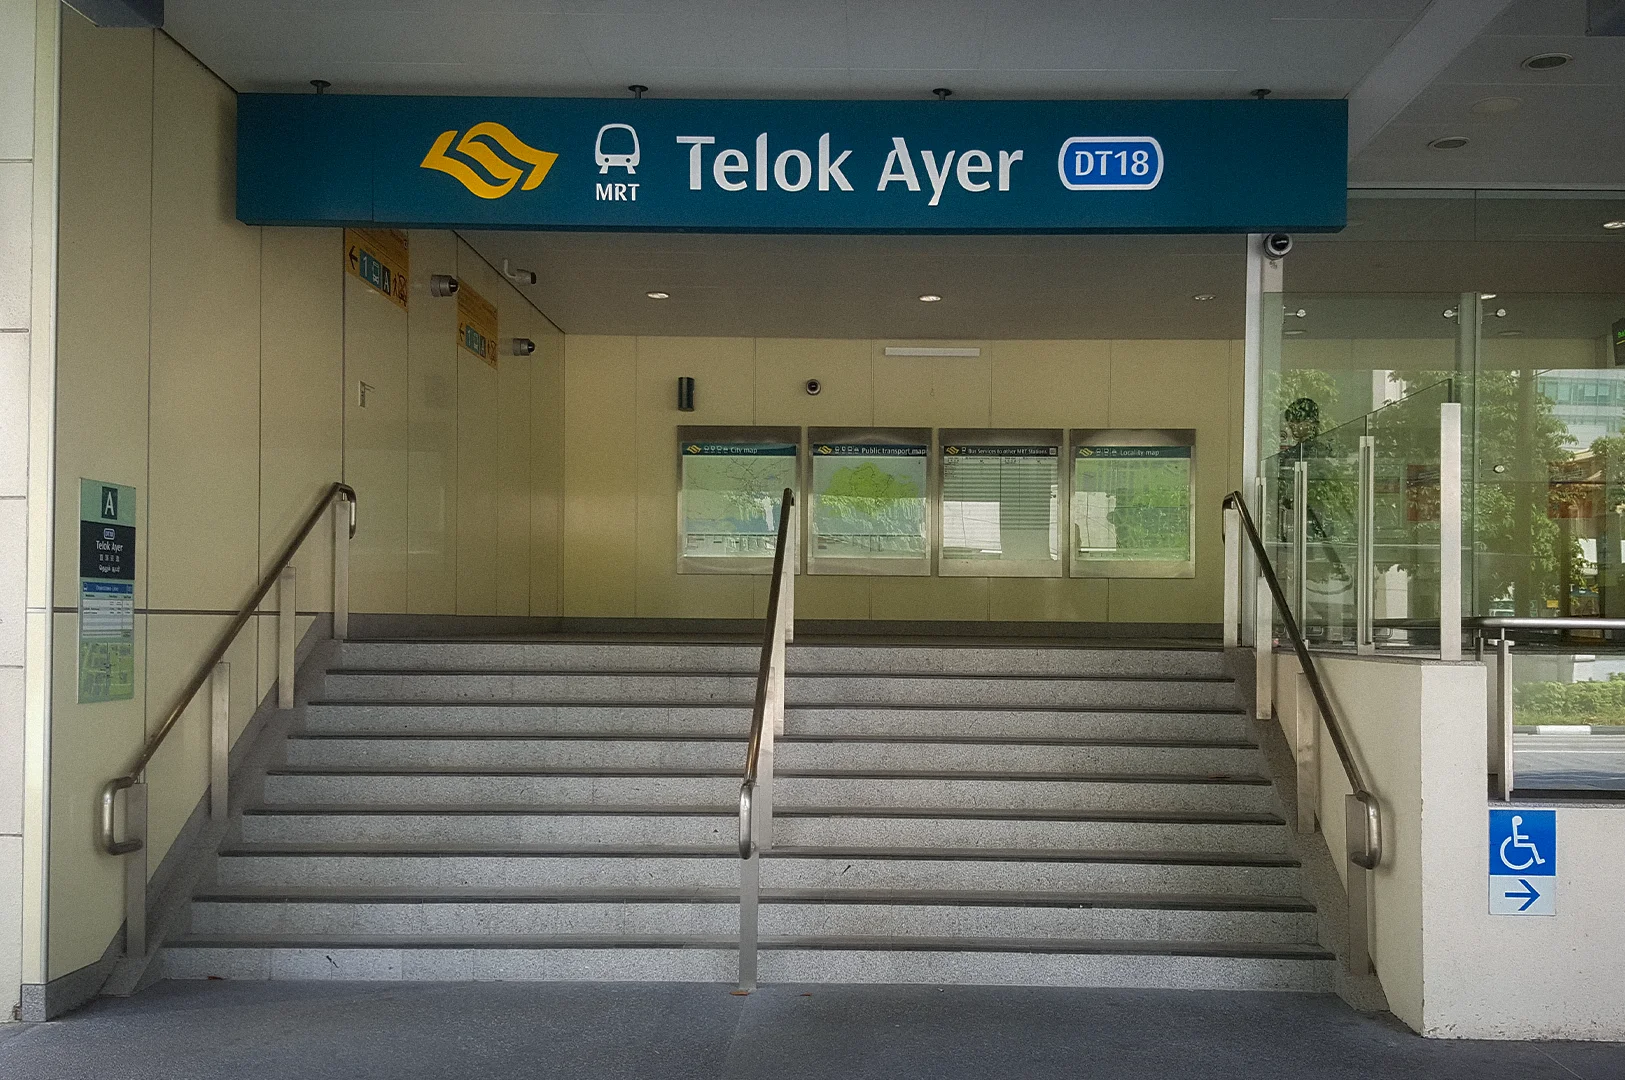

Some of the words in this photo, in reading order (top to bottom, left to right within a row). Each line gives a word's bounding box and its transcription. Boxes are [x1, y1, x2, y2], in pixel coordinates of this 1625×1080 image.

[676, 132, 854, 192] Telok
[876, 137, 1024, 206] Ayer
[1075, 150, 1149, 176] DT18
[596, 183, 640, 201] MRT
[362, 255, 368, 278] 1
[383, 270, 391, 293] A
[730, 446, 742, 454] City
[882, 447, 910, 455] transport
[104, 491, 114, 516] A
[96, 540, 110, 550] Telok
[111, 542, 123, 553] Ayer
